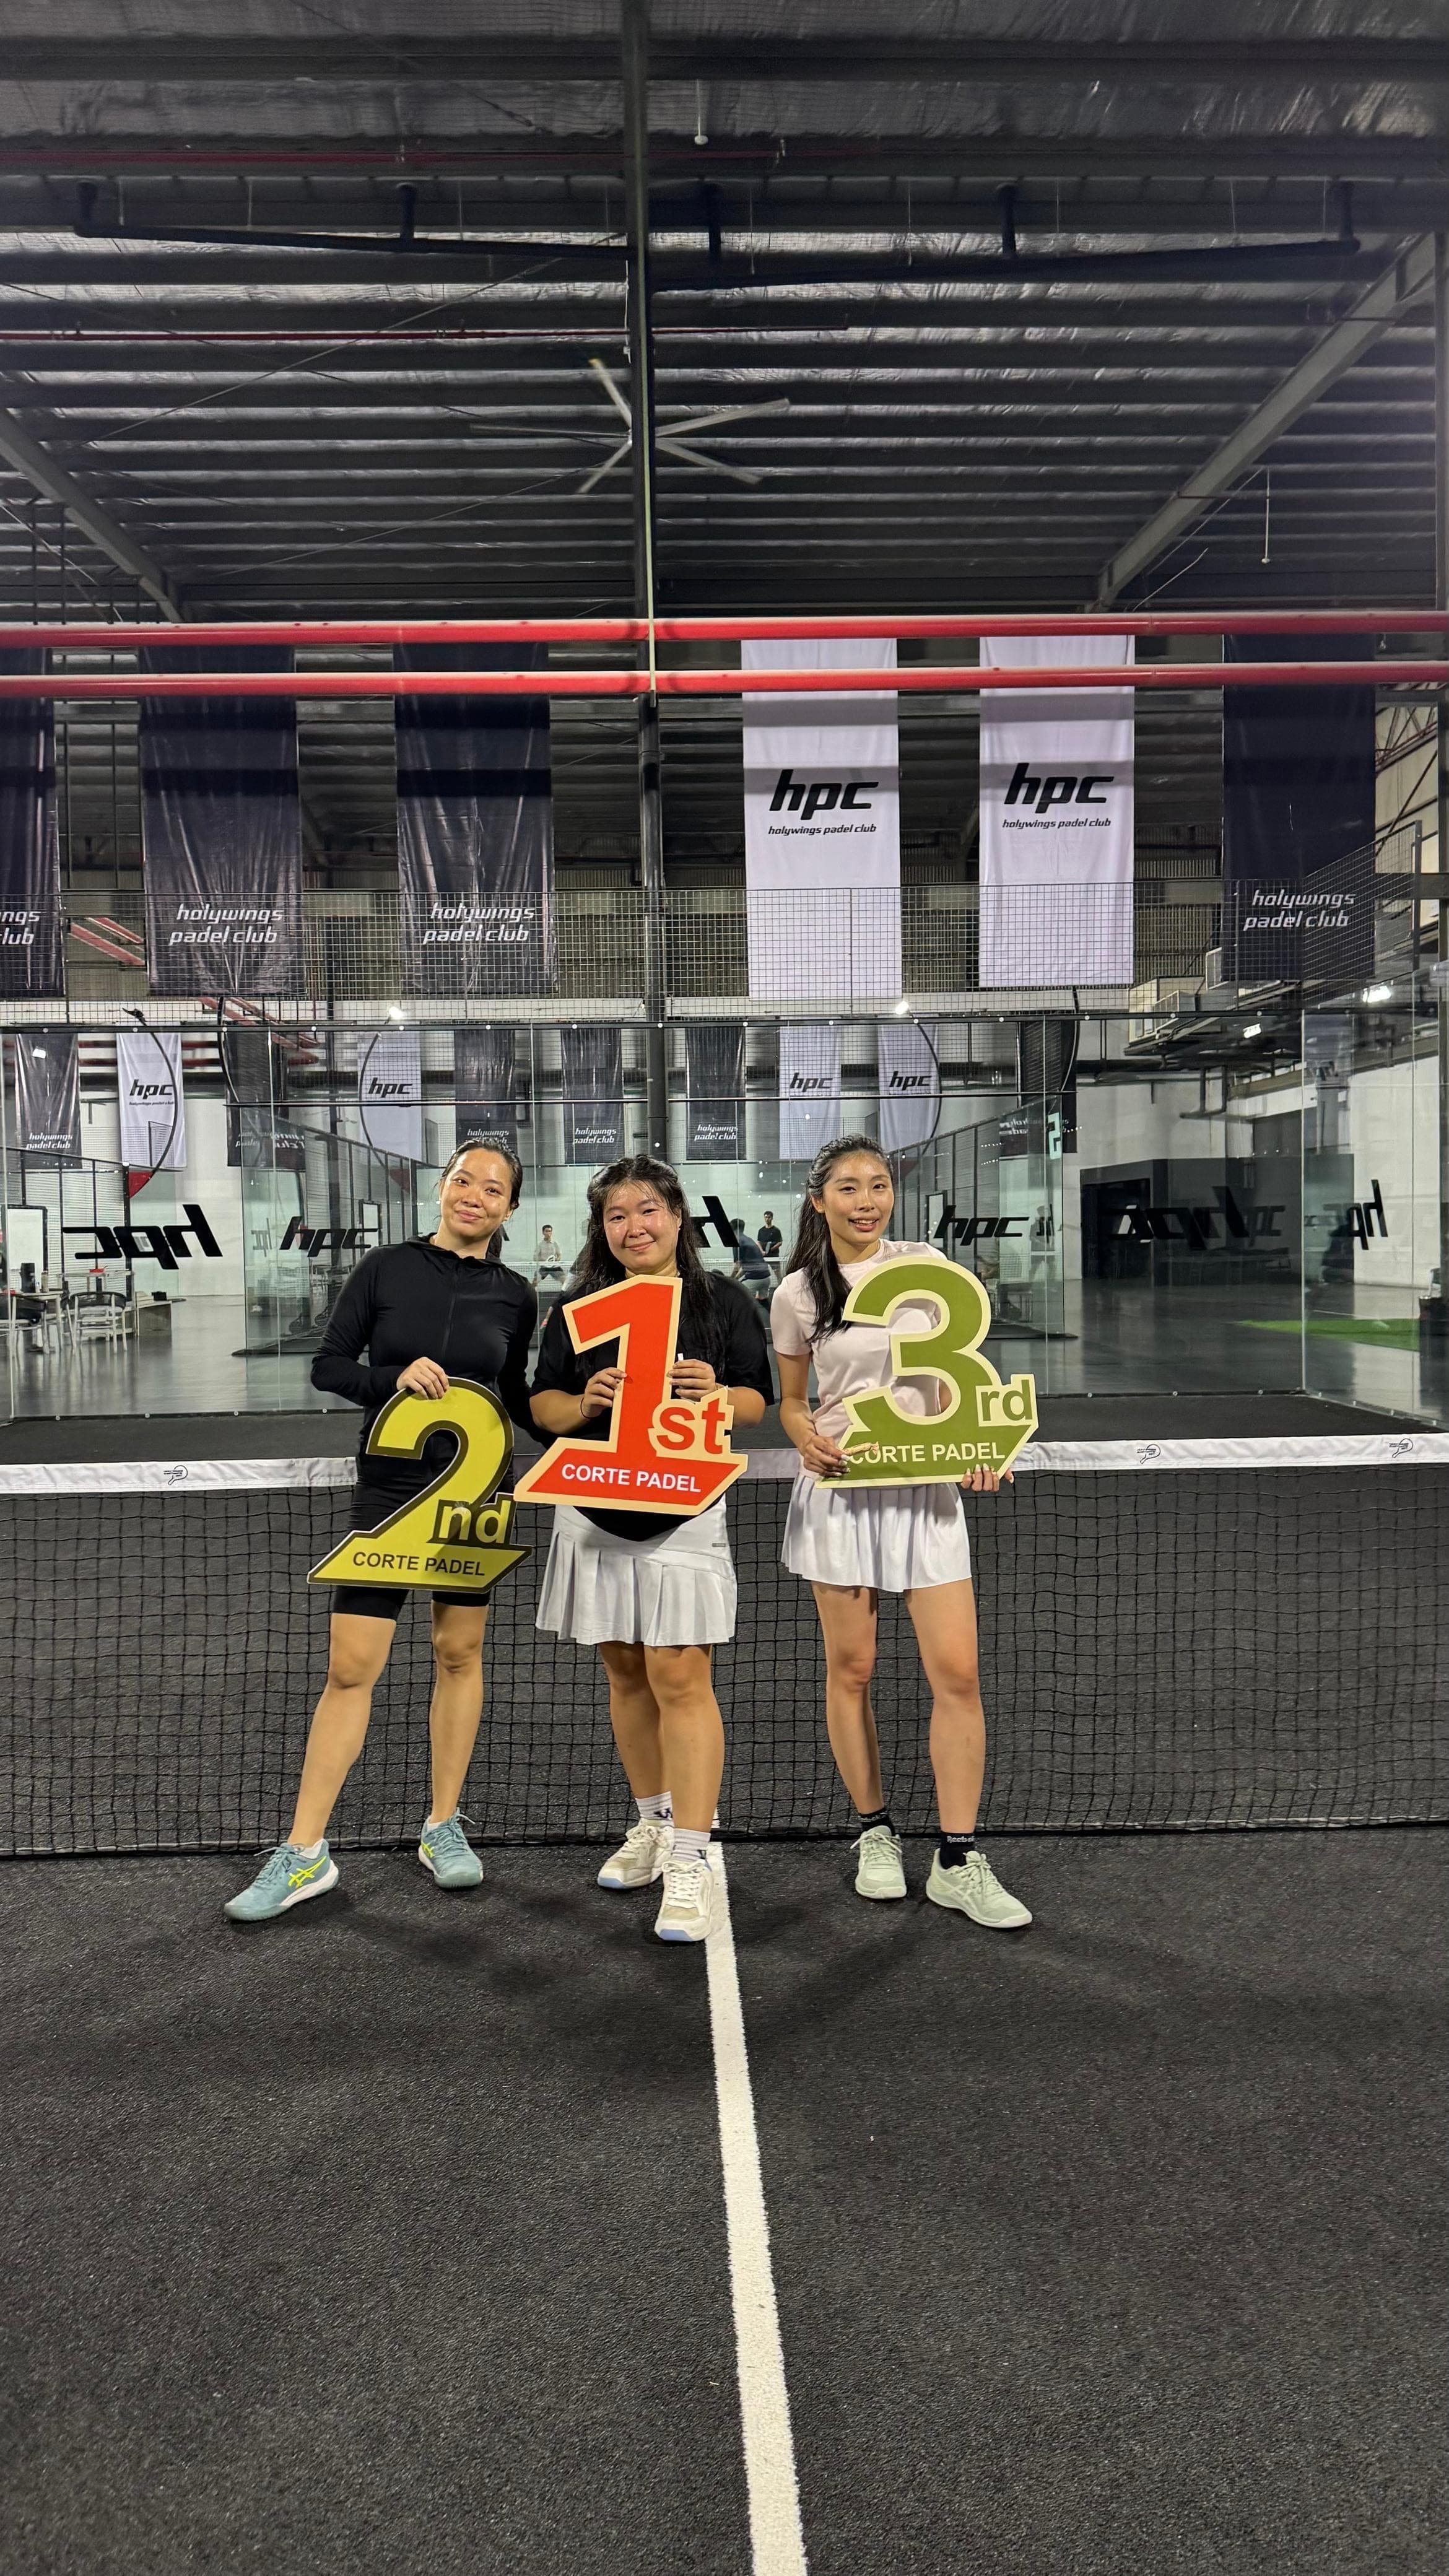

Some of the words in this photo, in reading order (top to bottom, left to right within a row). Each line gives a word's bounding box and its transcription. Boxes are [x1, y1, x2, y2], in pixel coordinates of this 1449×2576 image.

[770, 769, 879, 820] hpc
[1004, 762, 1115, 814] hpc
[768, 826, 822, 836] holywings
[823, 824, 853, 835] padel
[855, 824, 877, 832] club
[1003, 819, 1056, 829] holywings
[1058, 818, 1088, 829] padel
[1089, 818, 1112, 827] club
[1252, 889, 1356, 908] holywings
[176, 903, 285, 924] holywings
[430, 902, 535, 923] holywings
[1243, 910, 1303, 931] padel
[1305, 910, 1349, 927] club
[0, 927, 35, 945] lub
[168, 926, 230, 946] padel
[232, 926, 277, 943] club
[423, 925, 483, 945] padel
[485, 924, 529, 941] club
[129, 1079, 174, 1100] hpc
[368, 1077, 413, 1099] hpc
[790, 1072, 833, 1092] hpc
[889, 1071, 932, 1090] hpc
[575, 1128, 617, 1136] holywings
[933, 1204, 1030, 1246] hpc
[279, 1216, 380, 1258] hpc
[833, 1257, 1037, 1449] 3rd
[539, 1276, 737, 1502] 1st
[932, 1442, 1005, 1461] PADEL
[337, 1378, 525, 1576] 2nd
[562, 1463, 631, 1486] CORTE
[636, 1471, 701, 1492] PADEL
[352, 1551, 420, 1571] CORTE
[424, 1557, 485, 1577] PADEL
